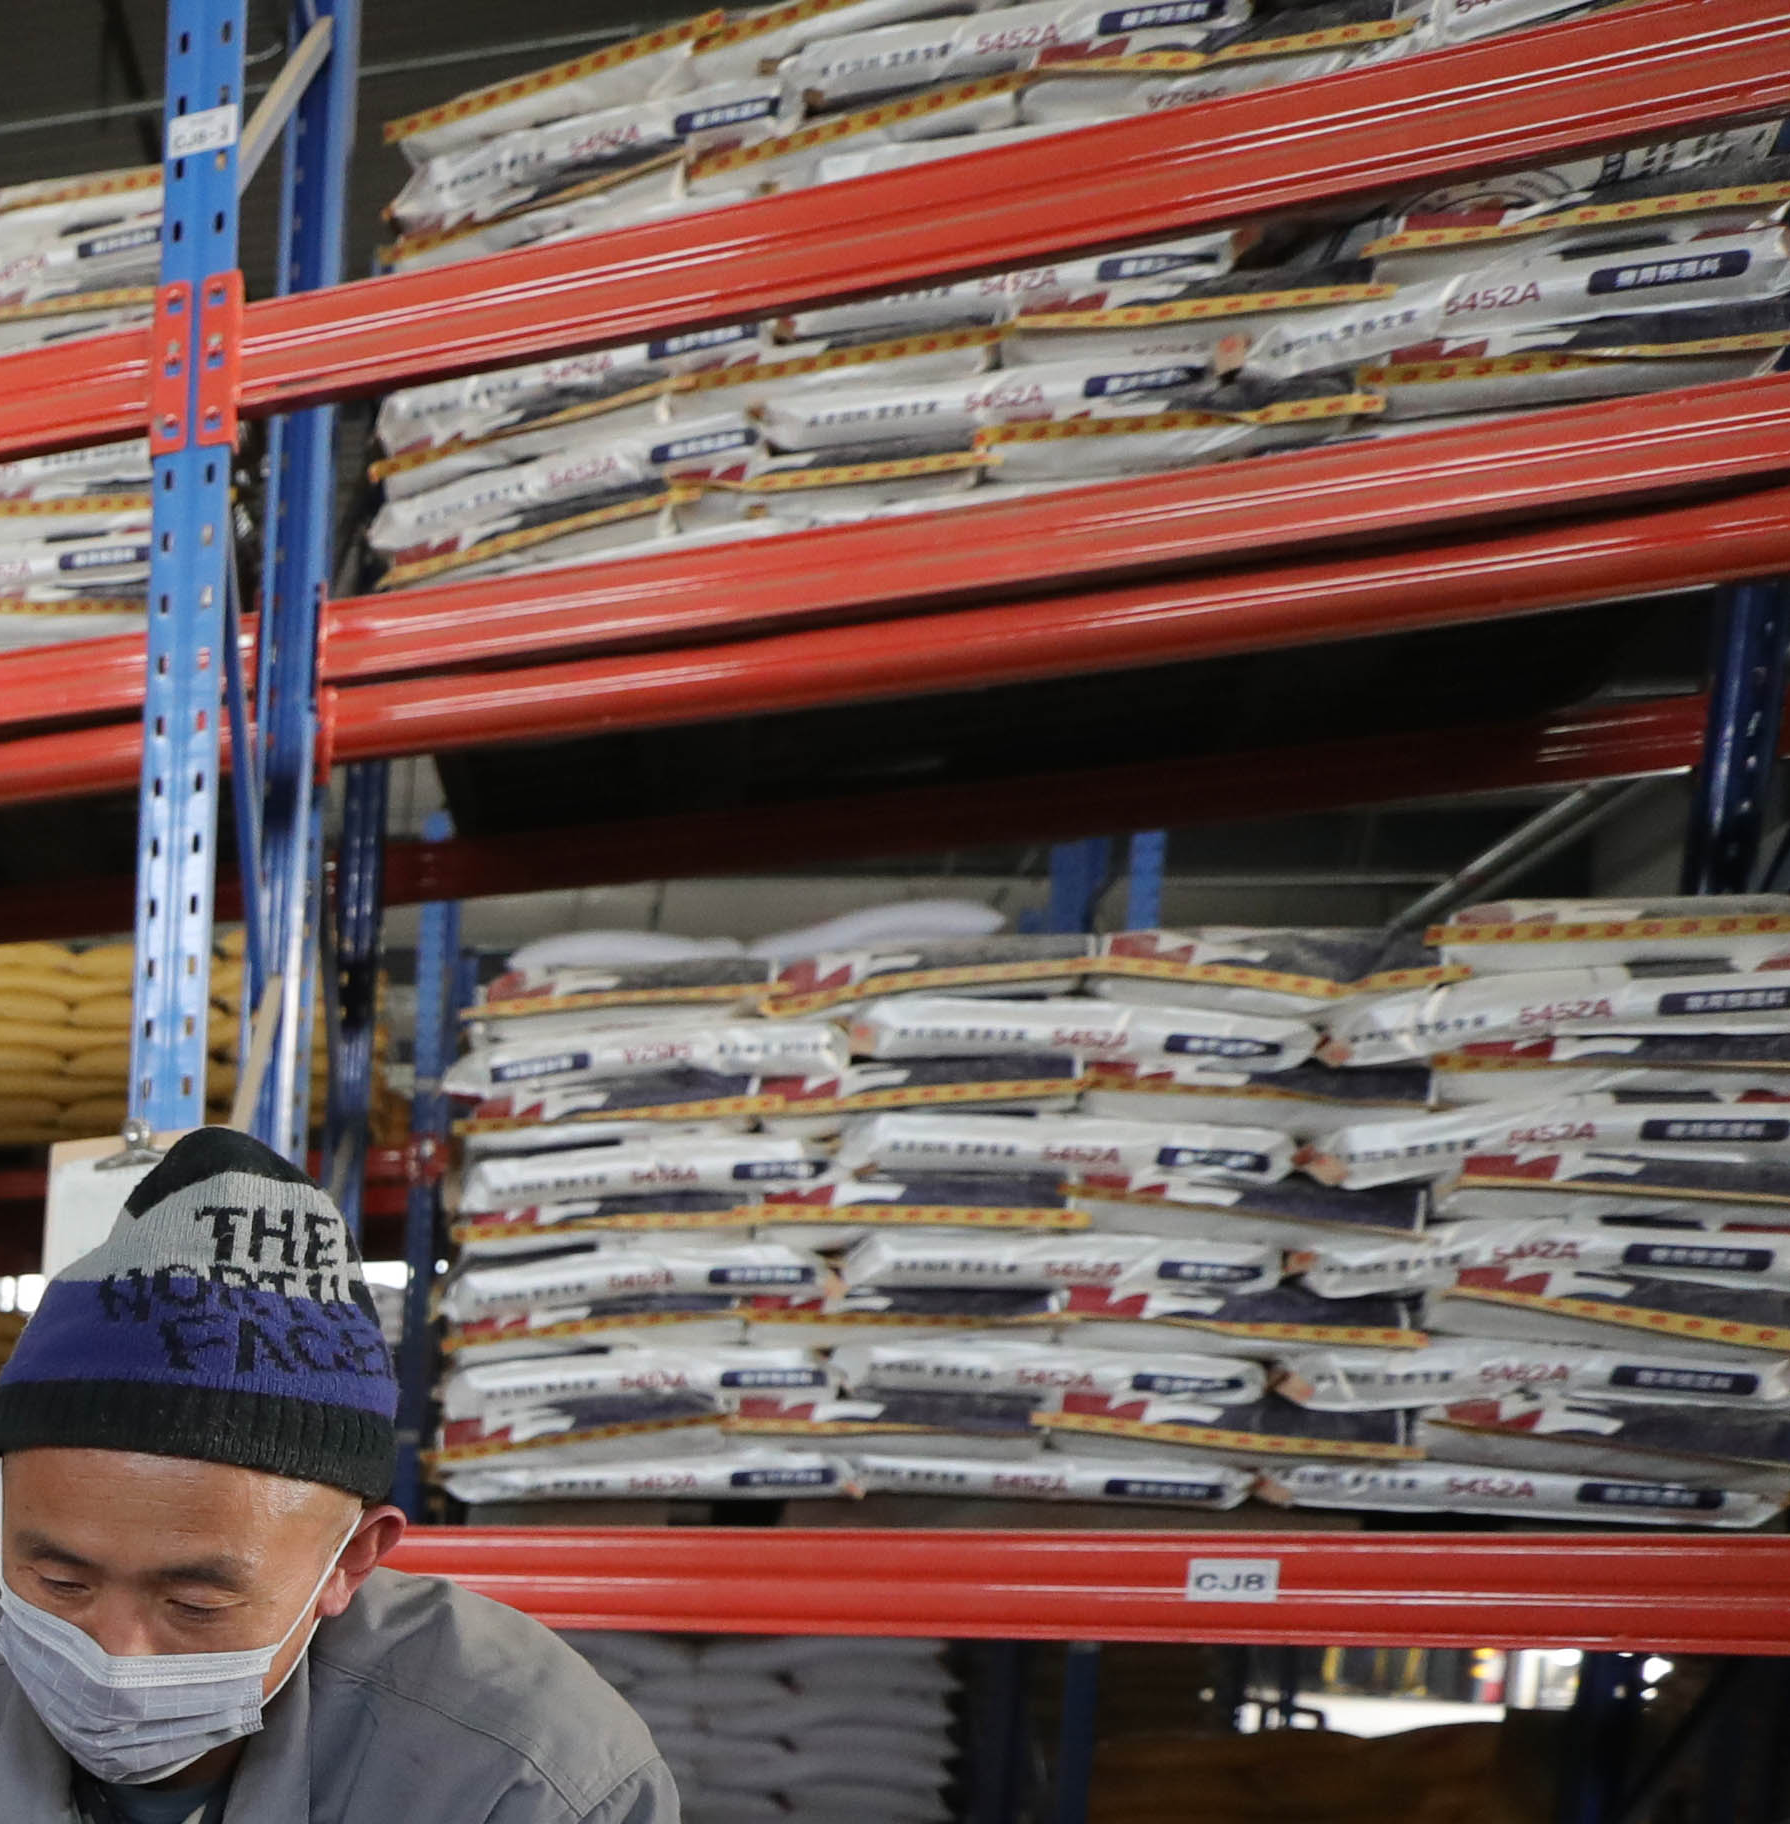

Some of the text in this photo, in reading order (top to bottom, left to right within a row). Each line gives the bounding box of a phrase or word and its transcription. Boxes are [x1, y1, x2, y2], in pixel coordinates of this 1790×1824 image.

[1445, 281, 1542, 316] 5452A
[196, 1205, 340, 1269] THE
[157, 1312, 388, 1379] FACE
